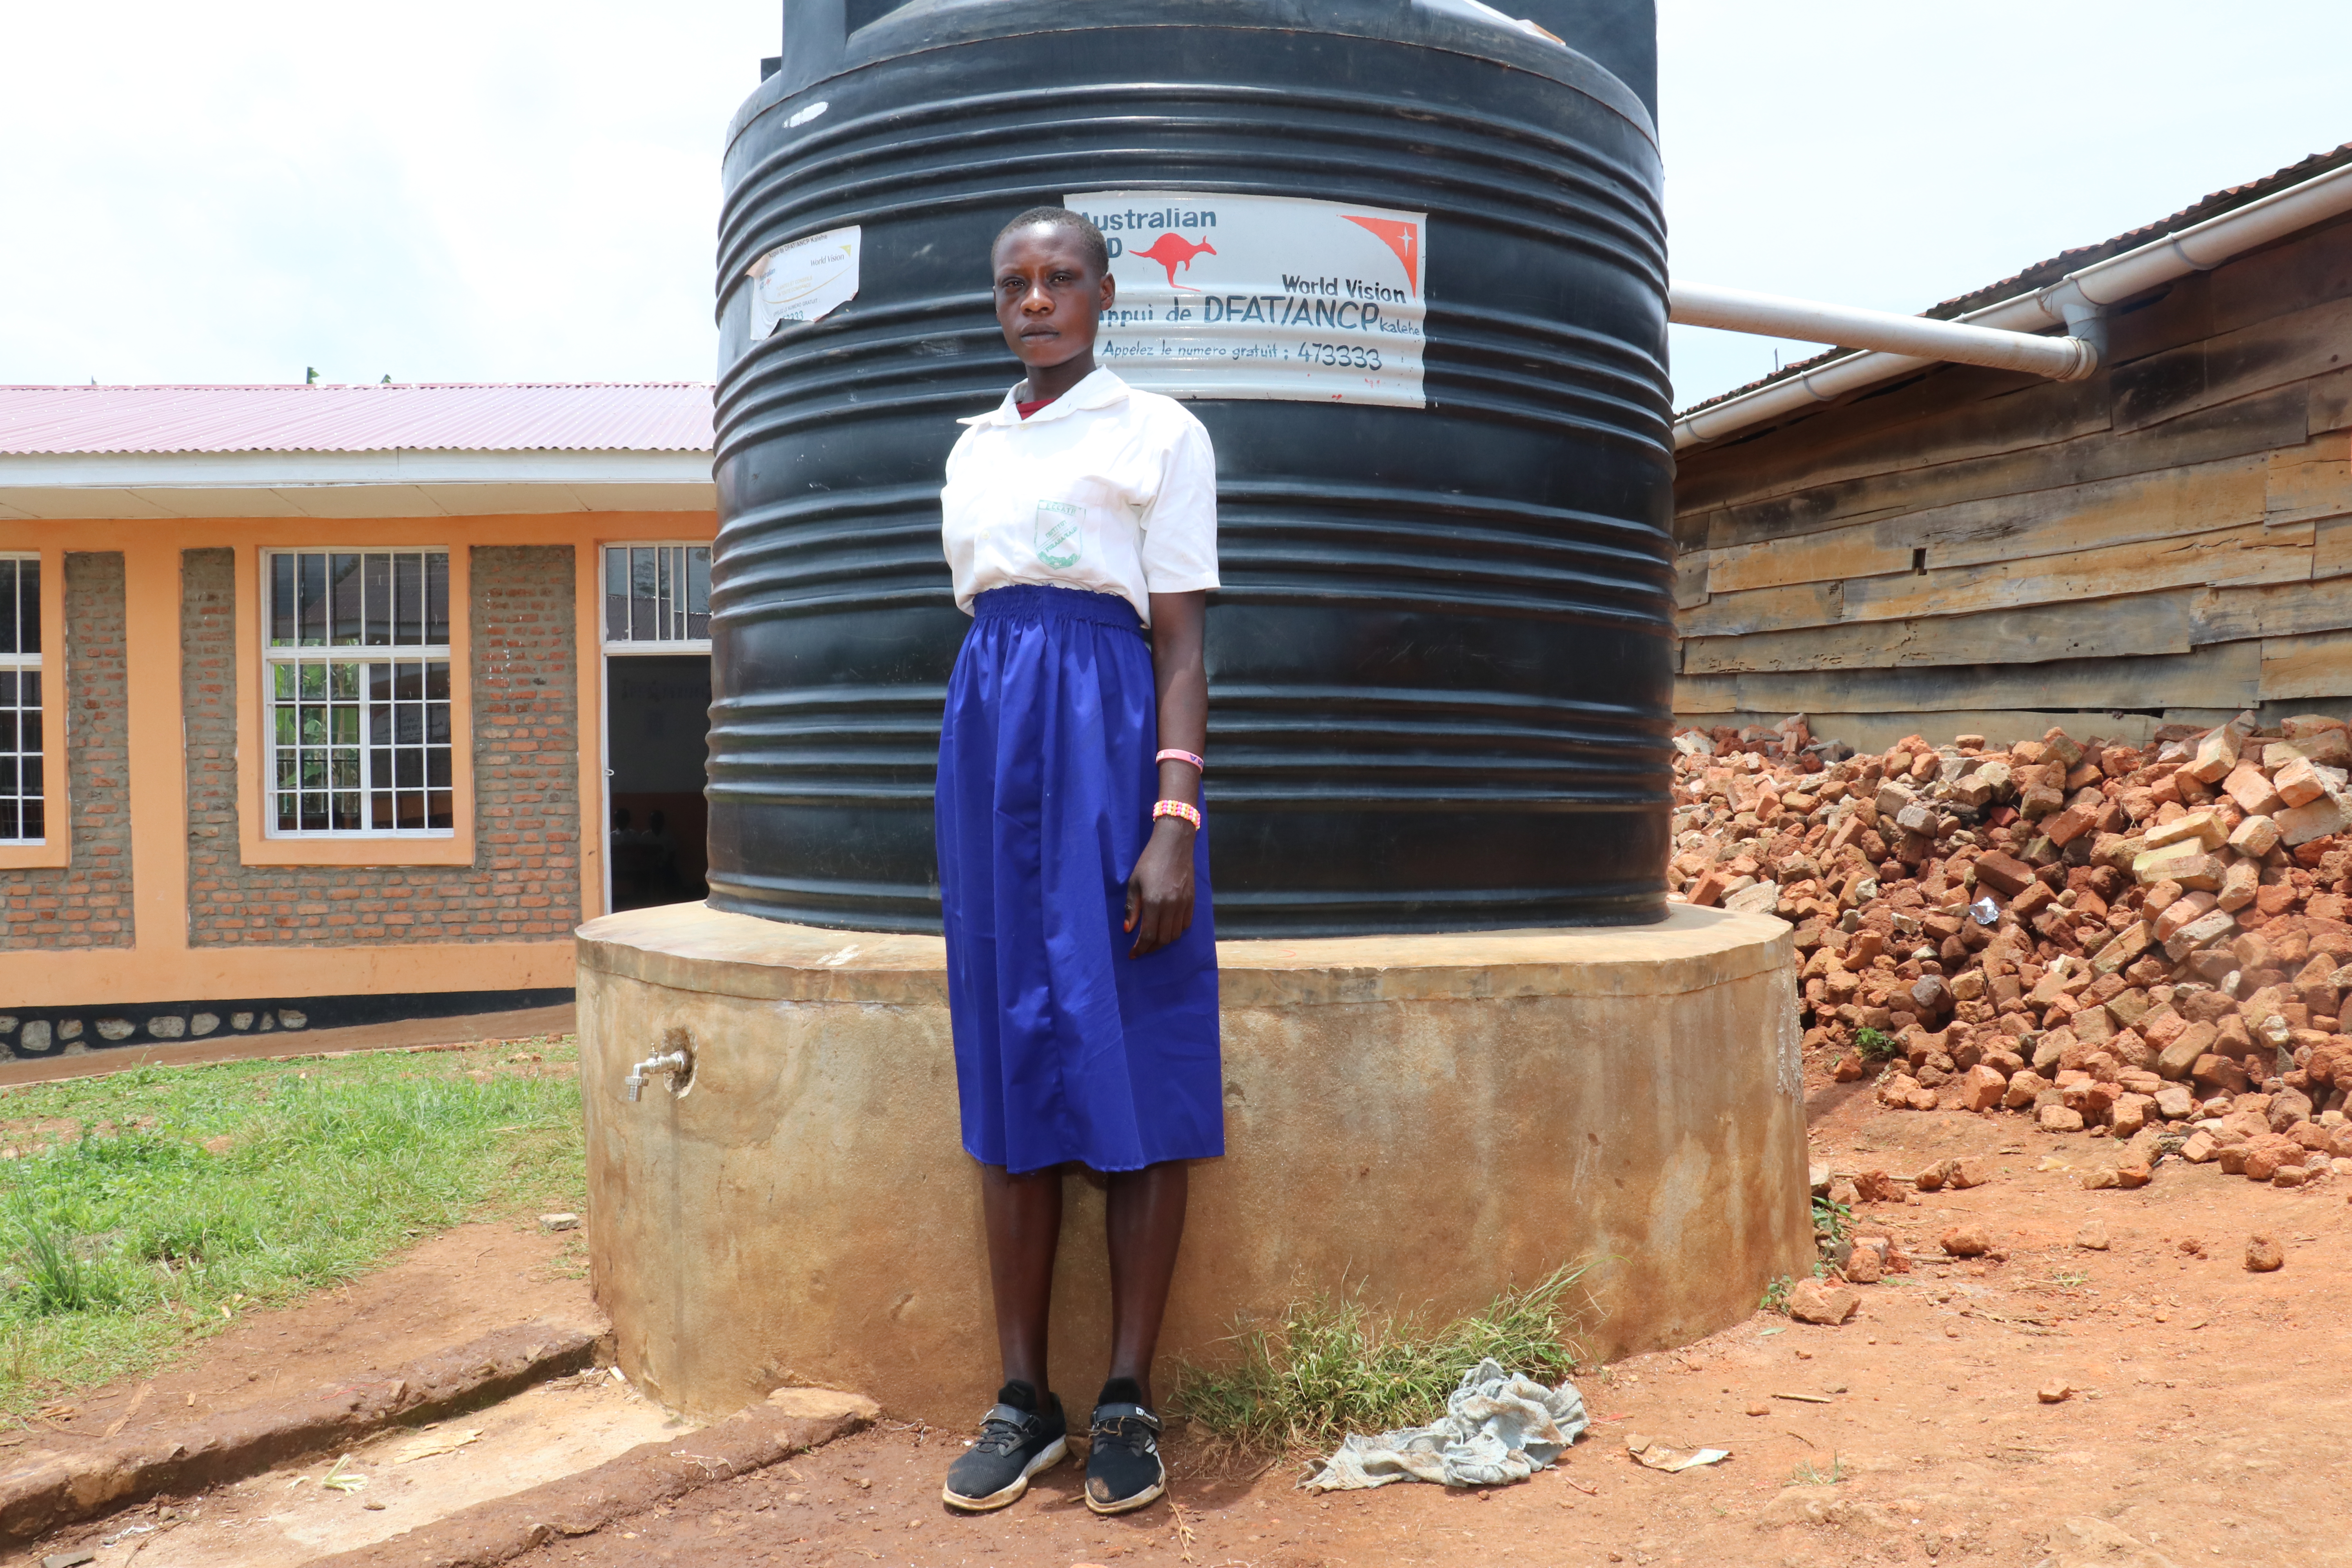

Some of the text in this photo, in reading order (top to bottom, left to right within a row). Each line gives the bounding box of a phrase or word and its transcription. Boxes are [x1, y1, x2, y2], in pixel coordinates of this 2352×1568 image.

[784, 239, 809, 252] DFAT/ANCP
[810, 234, 828, 243] Kalehe
[810, 254, 844, 267] World Vision
[1282, 274, 1407, 303] World Vision
[802, 298, 818, 306] GRATUIT
[1165, 296, 1192, 323] de
[1204, 295, 1379, 331] DFAT/ANCP
[1102, 340, 1154, 359] Appelez
[1161, 339, 1172, 356] le
[1178, 346, 1227, 356] numero
[1232, 342, 1278, 361] gratuit
[1298, 342, 1382, 371] 473333
